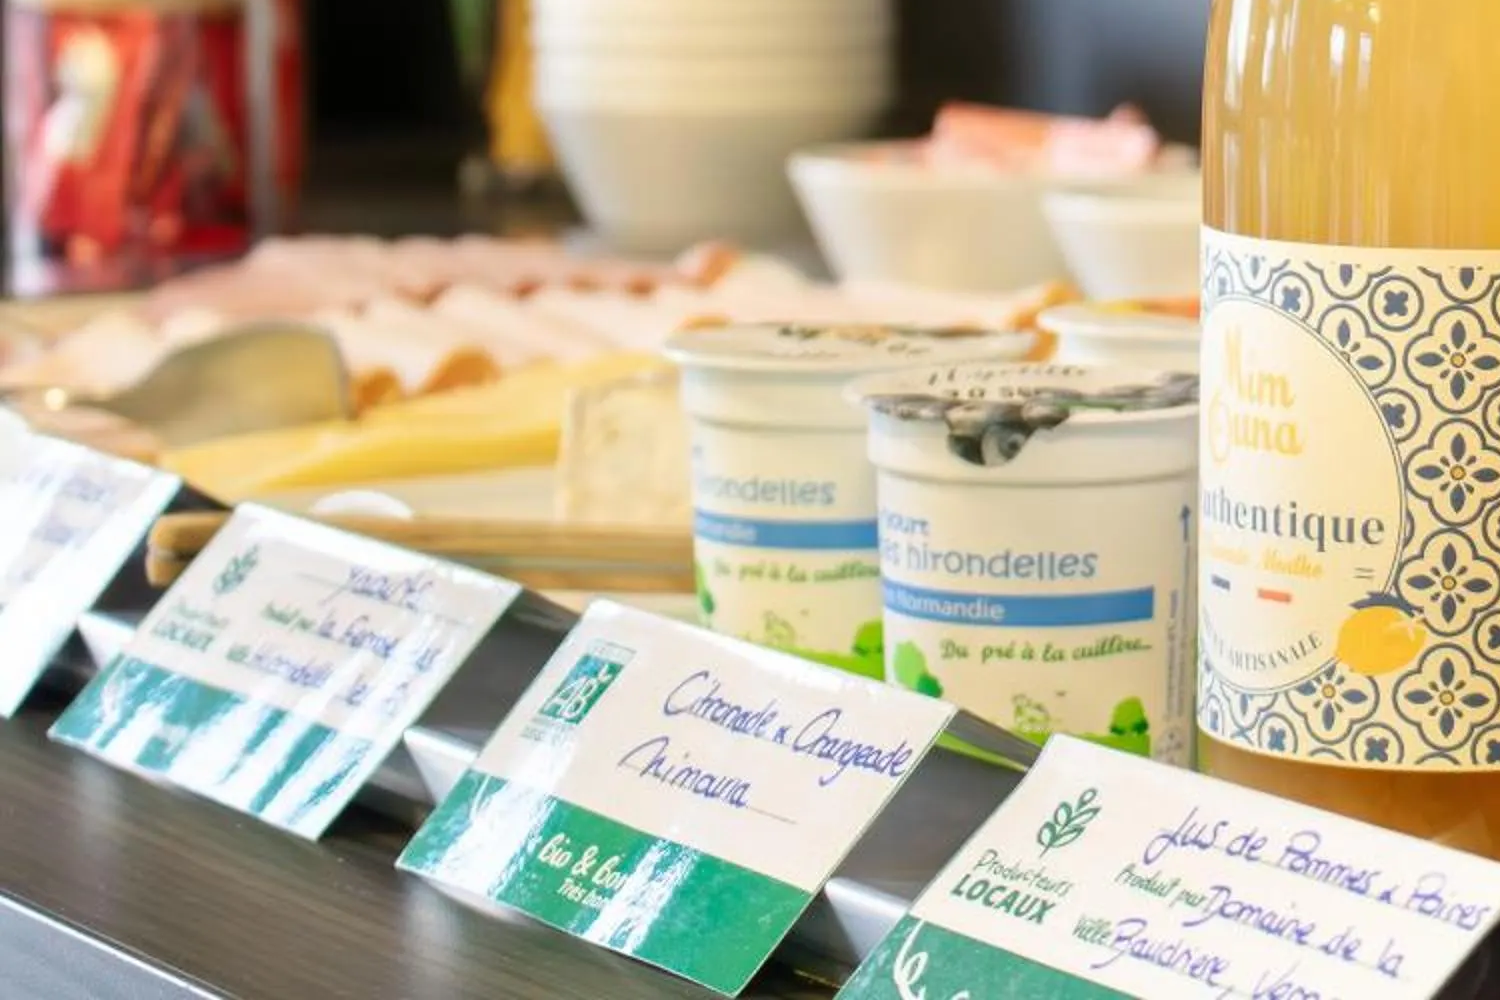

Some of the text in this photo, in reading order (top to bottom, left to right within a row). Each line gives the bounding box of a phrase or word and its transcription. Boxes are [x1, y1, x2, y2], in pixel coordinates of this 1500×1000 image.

[1202, 485, 1386, 552] uthentique
[906, 542, 1099, 581] hirondelles
[939, 637, 969, 660] Du
[981, 638, 1018, 665] pré
[1041, 640, 1065, 663] la
[546, 676, 597, 718] AB
[537, 832, 573, 869] Bio
[570, 844, 599, 877] &
[973, 848, 1074, 899] Producteurs
[1143, 806, 1228, 865] Jus
[1225, 826, 1268, 862] de
[1279, 830, 1381, 896] Pommes
[1404, 871, 1491, 931] Poires
[951, 872, 1057, 924] LOCAUX
[1114, 862, 1181, 898] Produit
[1181, 884, 1405, 979] Domaine de la
